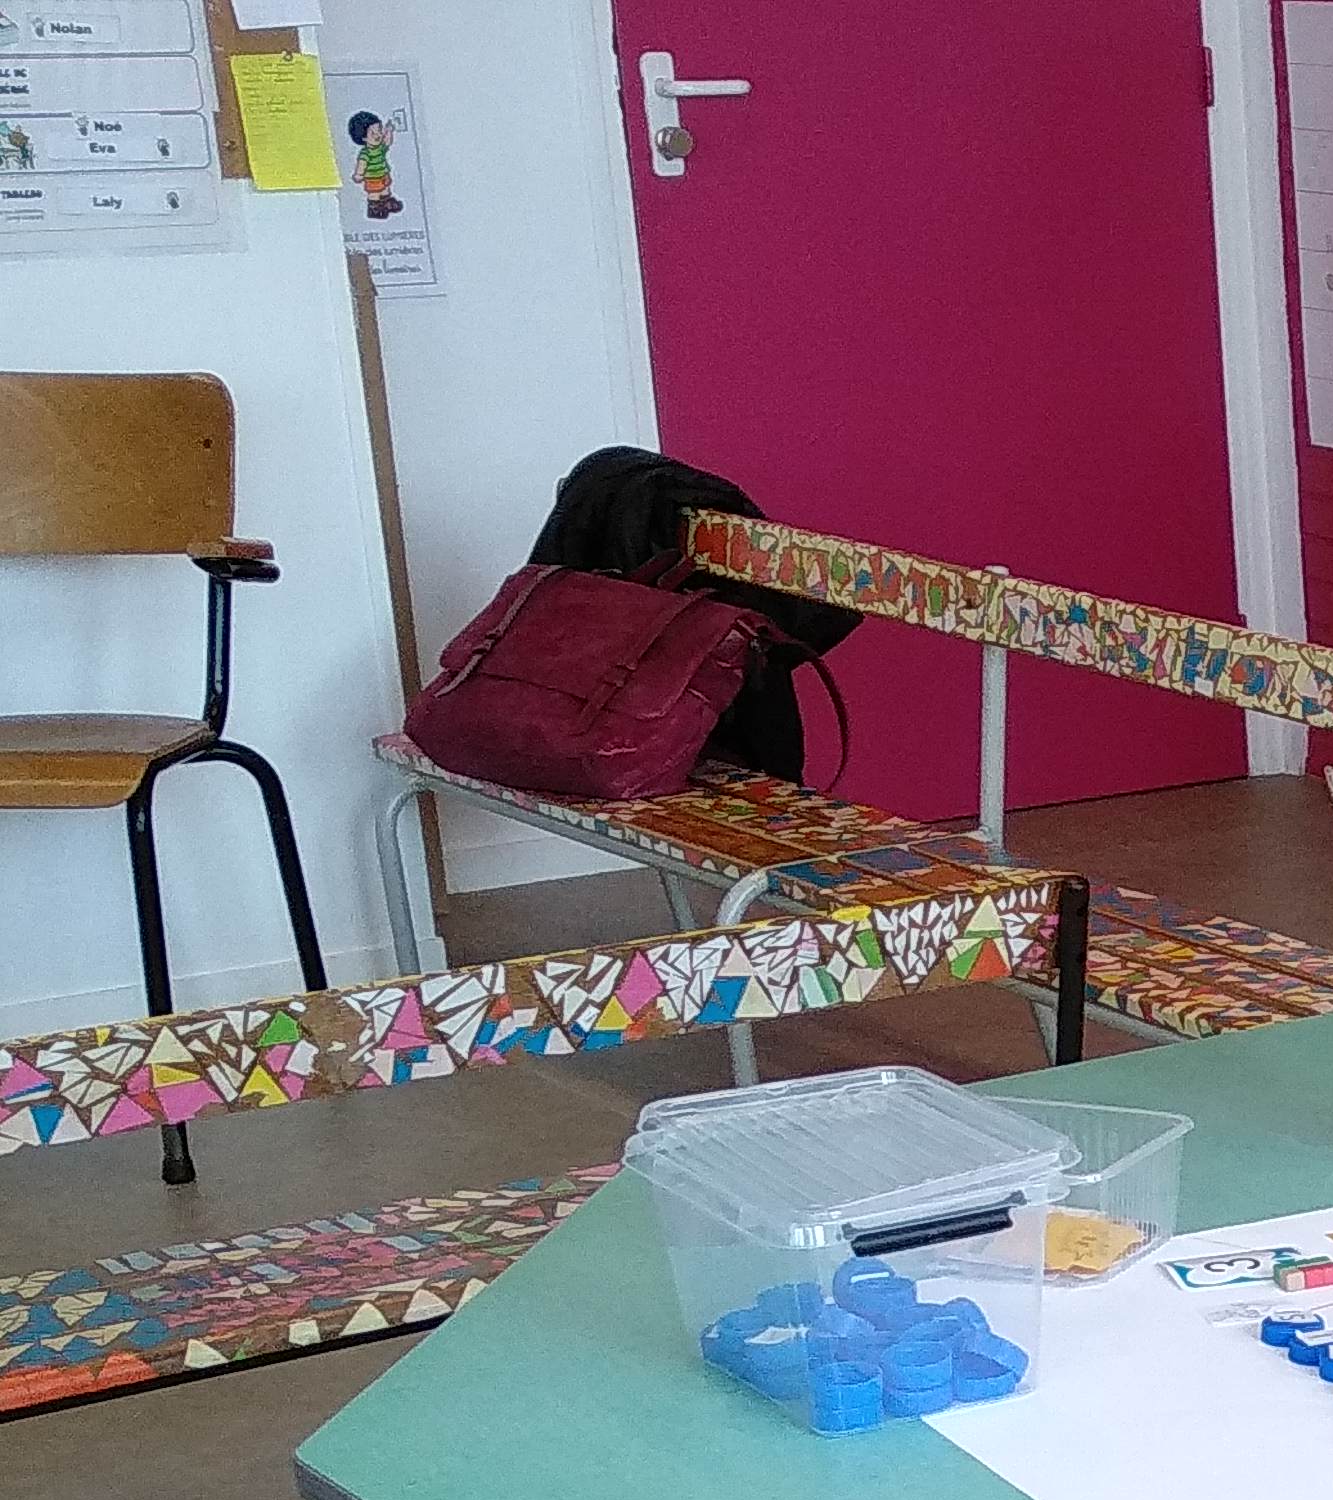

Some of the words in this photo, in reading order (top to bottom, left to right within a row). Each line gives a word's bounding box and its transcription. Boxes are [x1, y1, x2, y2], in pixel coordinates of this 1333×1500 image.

[50, 22, 93, 35] Nolan
[89, 142, 116, 154] Eva
[93, 196, 123, 210] Laly
[1204, 1257, 1262, 1273] 3
